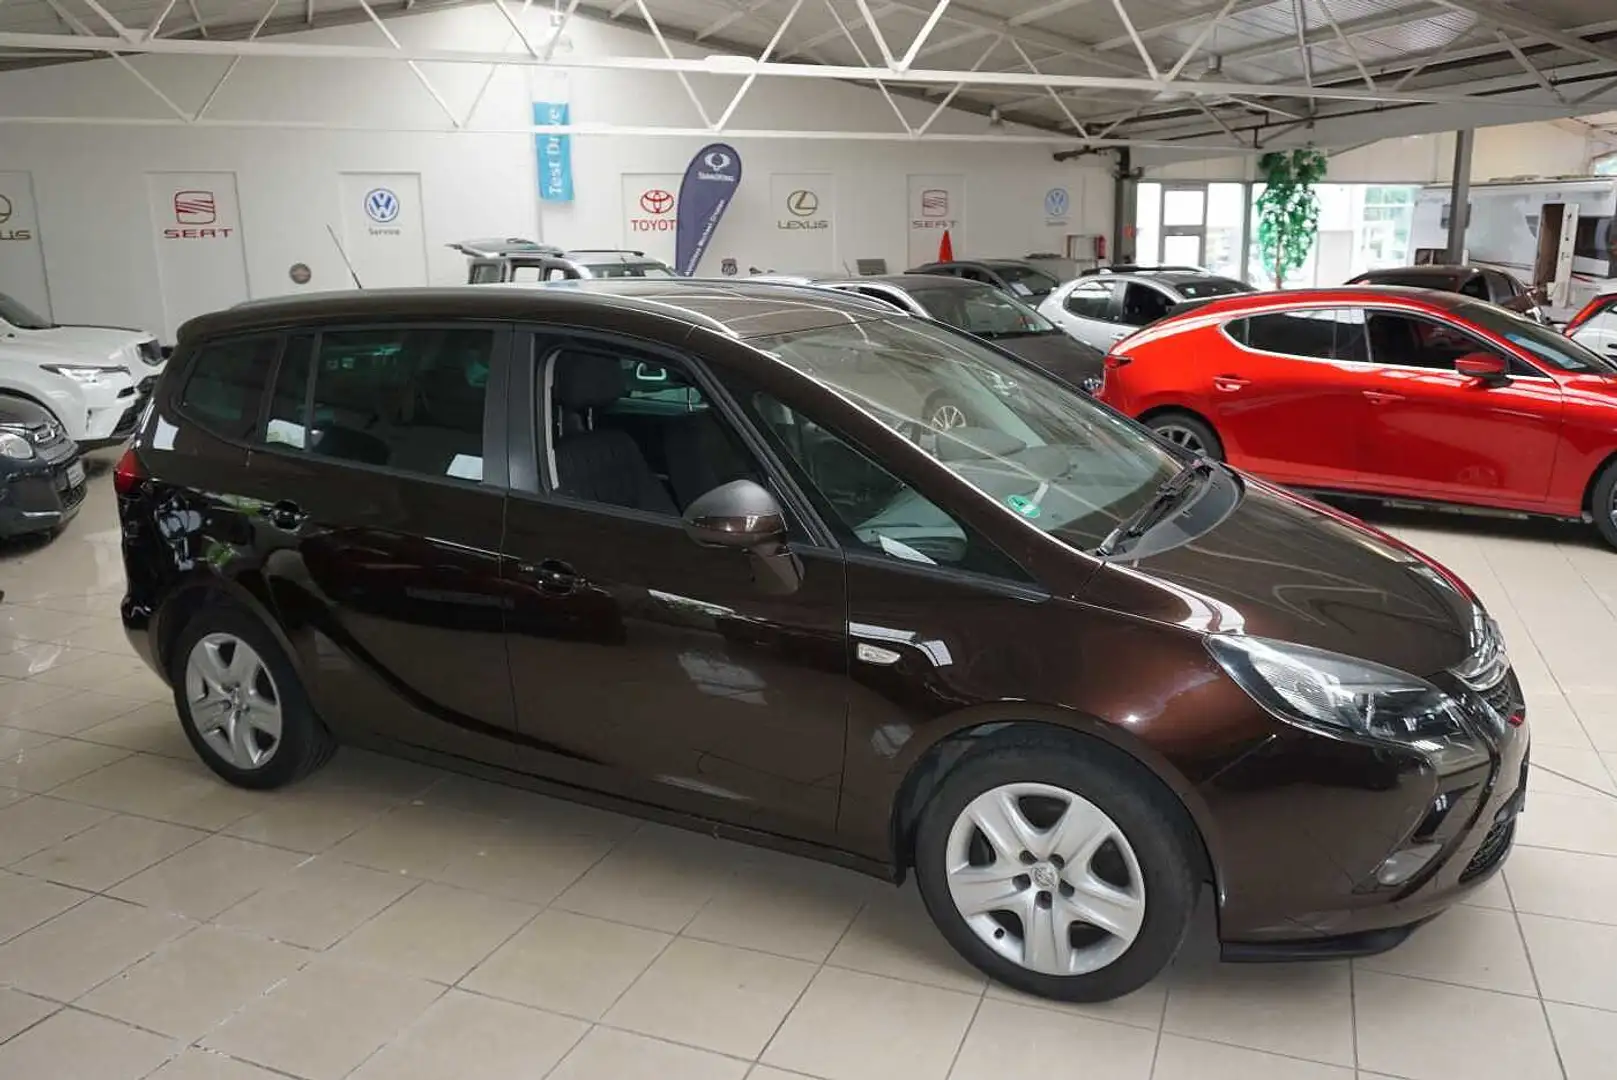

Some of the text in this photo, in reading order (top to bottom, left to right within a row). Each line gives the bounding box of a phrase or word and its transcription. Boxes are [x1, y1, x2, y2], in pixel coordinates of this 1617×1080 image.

[546, 107, 563, 195] Test Drve
[631, 219, 677, 231] TOYOT
[777, 220, 829, 230] LEXUS
[911, 219, 960, 229] SEAT
[163, 228, 233, 239] SEAT
